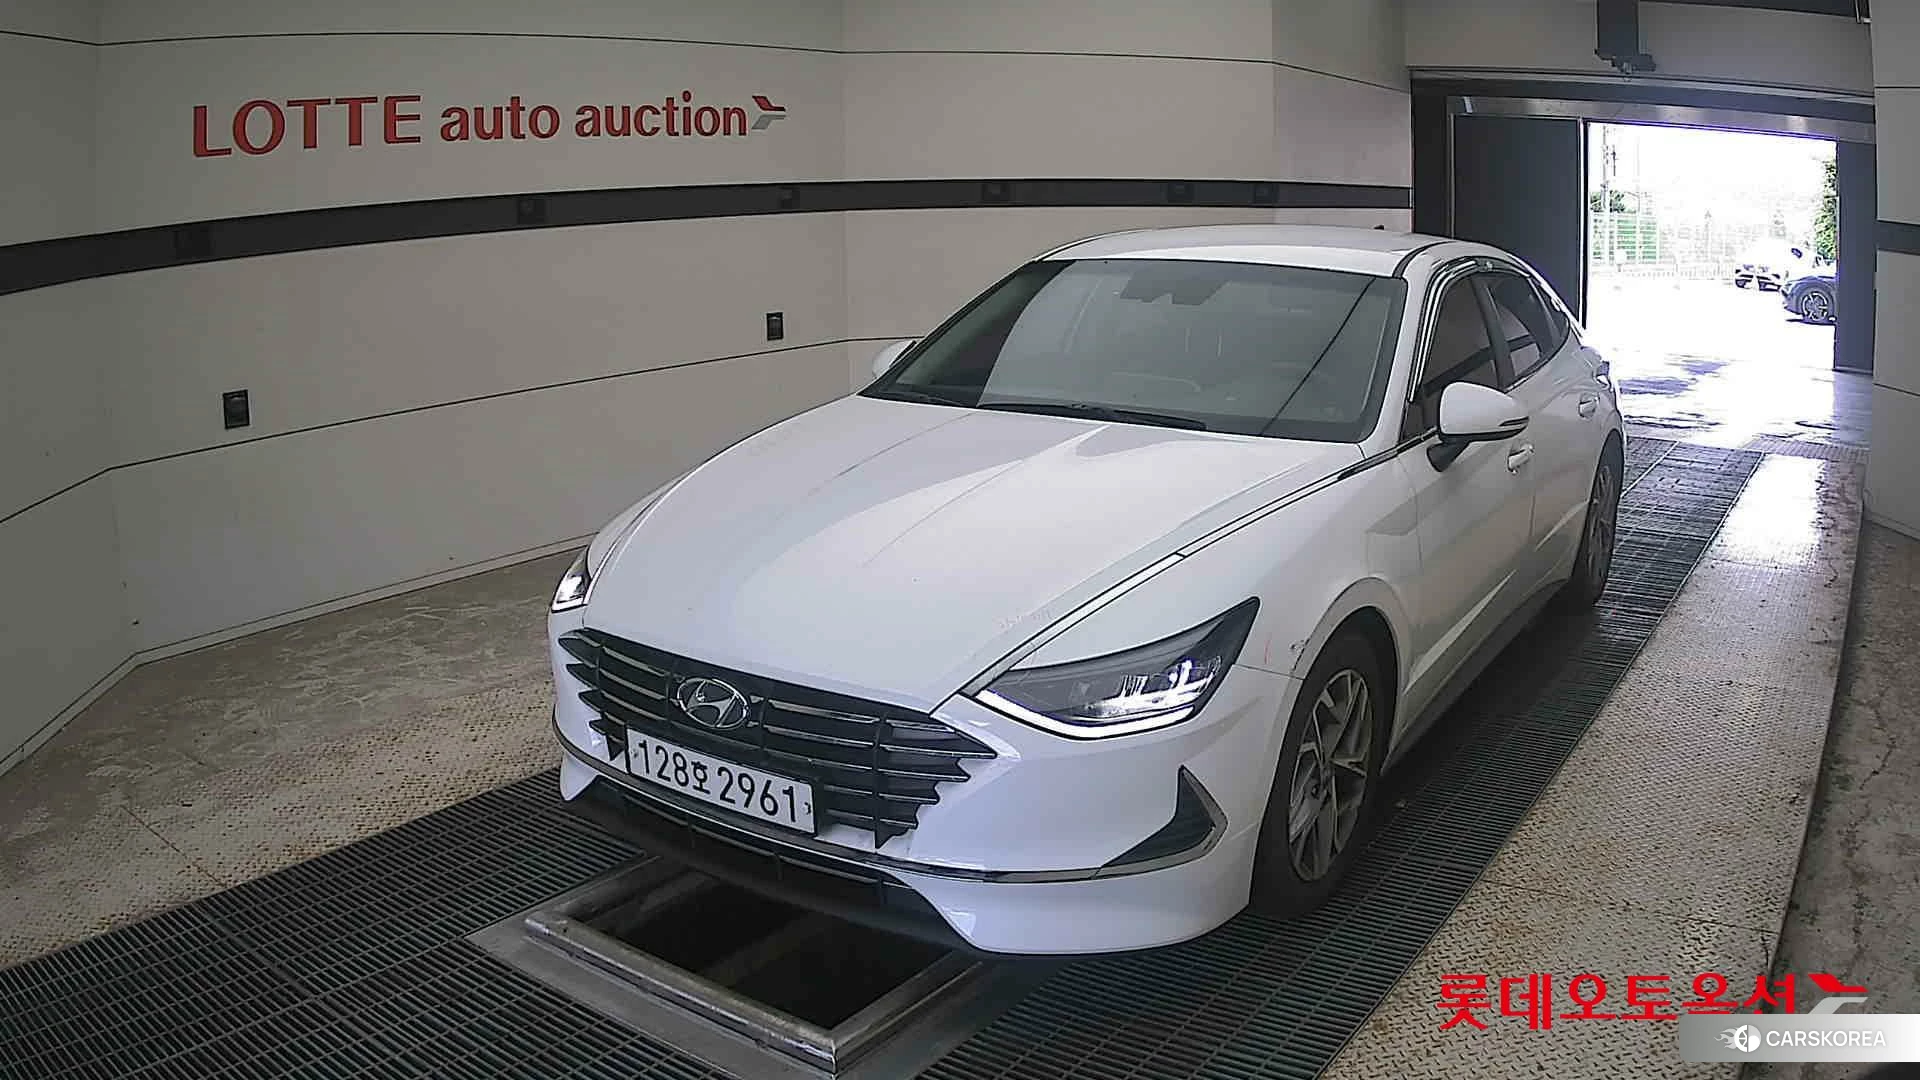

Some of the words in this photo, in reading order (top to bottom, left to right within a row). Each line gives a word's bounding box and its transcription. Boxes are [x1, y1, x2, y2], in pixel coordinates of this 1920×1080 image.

[193, 95, 421, 158] LOTTE
[440, 96, 560, 142] auto
[575, 91, 747, 137] auction
